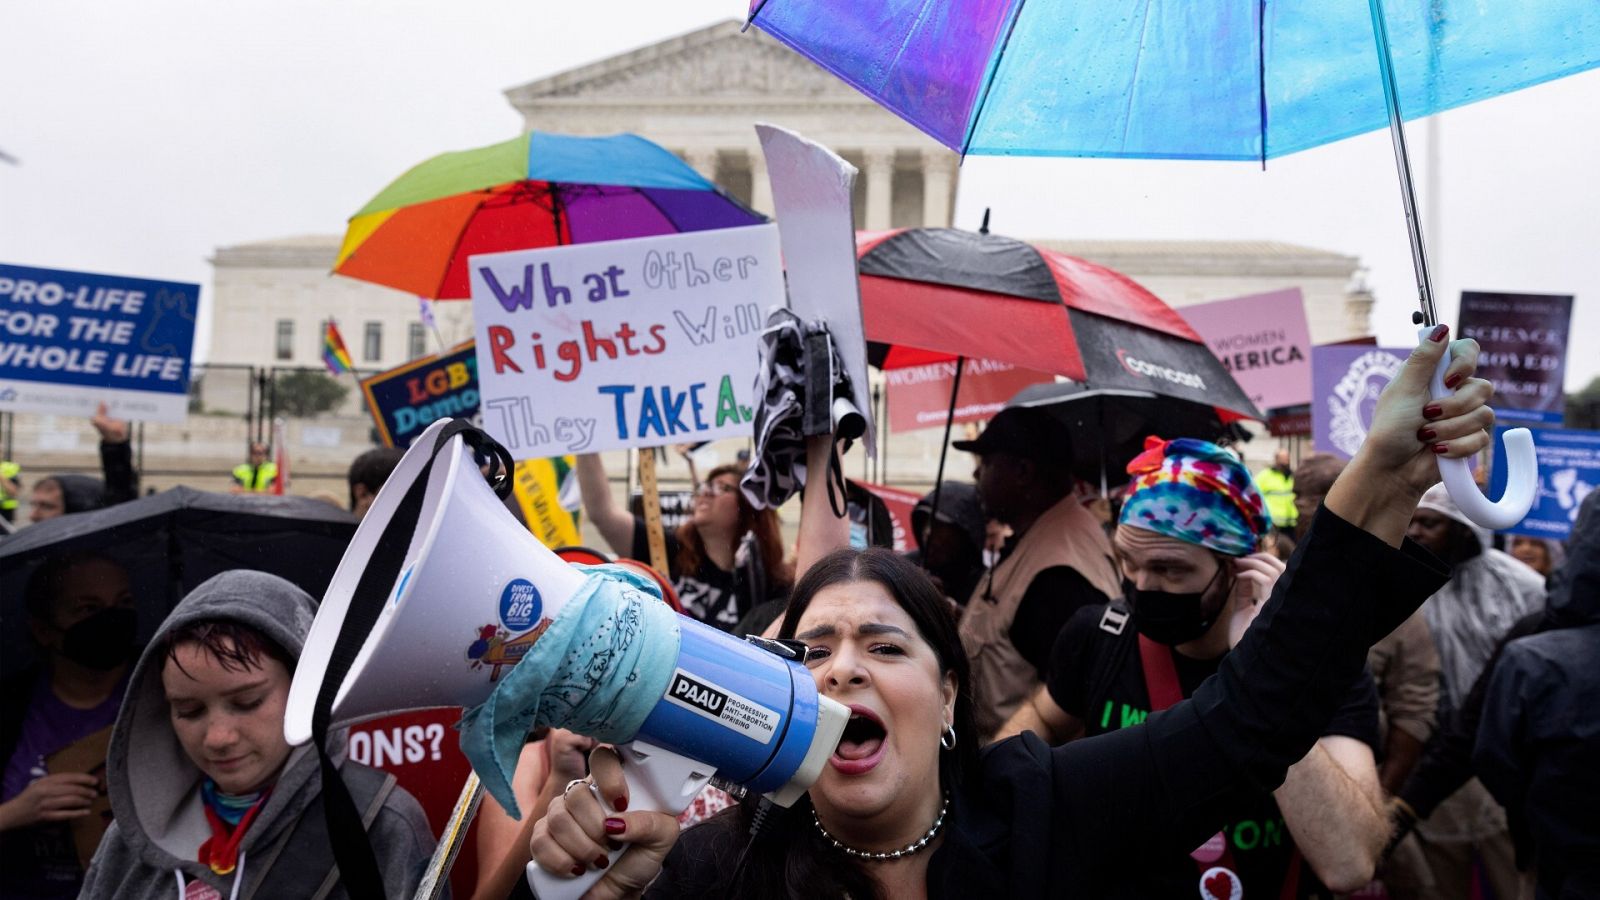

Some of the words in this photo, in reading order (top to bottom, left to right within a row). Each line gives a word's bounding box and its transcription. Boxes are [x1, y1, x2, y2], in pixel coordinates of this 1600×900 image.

[477, 262, 630, 313] What
[643, 249, 758, 289] Other
[68, 316, 136, 345] THE
[487, 320, 666, 382] Rights
[673, 303, 761, 347] Will
[1213, 329, 1286, 352] WOMEN
[111, 353, 185, 381] LIFE
[889, 358, 957, 386] WOMEN
[392, 389, 479, 435] Demo
[486, 395, 596, 451] They
[598, 382, 709, 440] TAKE
[509, 593, 534, 603] FROM
[511, 584, 534, 594] DIVEST
[507, 602, 533, 617] BIG
[675, 679, 722, 711] PAAU
[727, 697, 769, 721] PROGRESSIVE
[721, 712, 750, 730] UPRISING
[724, 705, 773, 732] ANTI-ABORTION
[350, 723, 445, 768] ONS?
